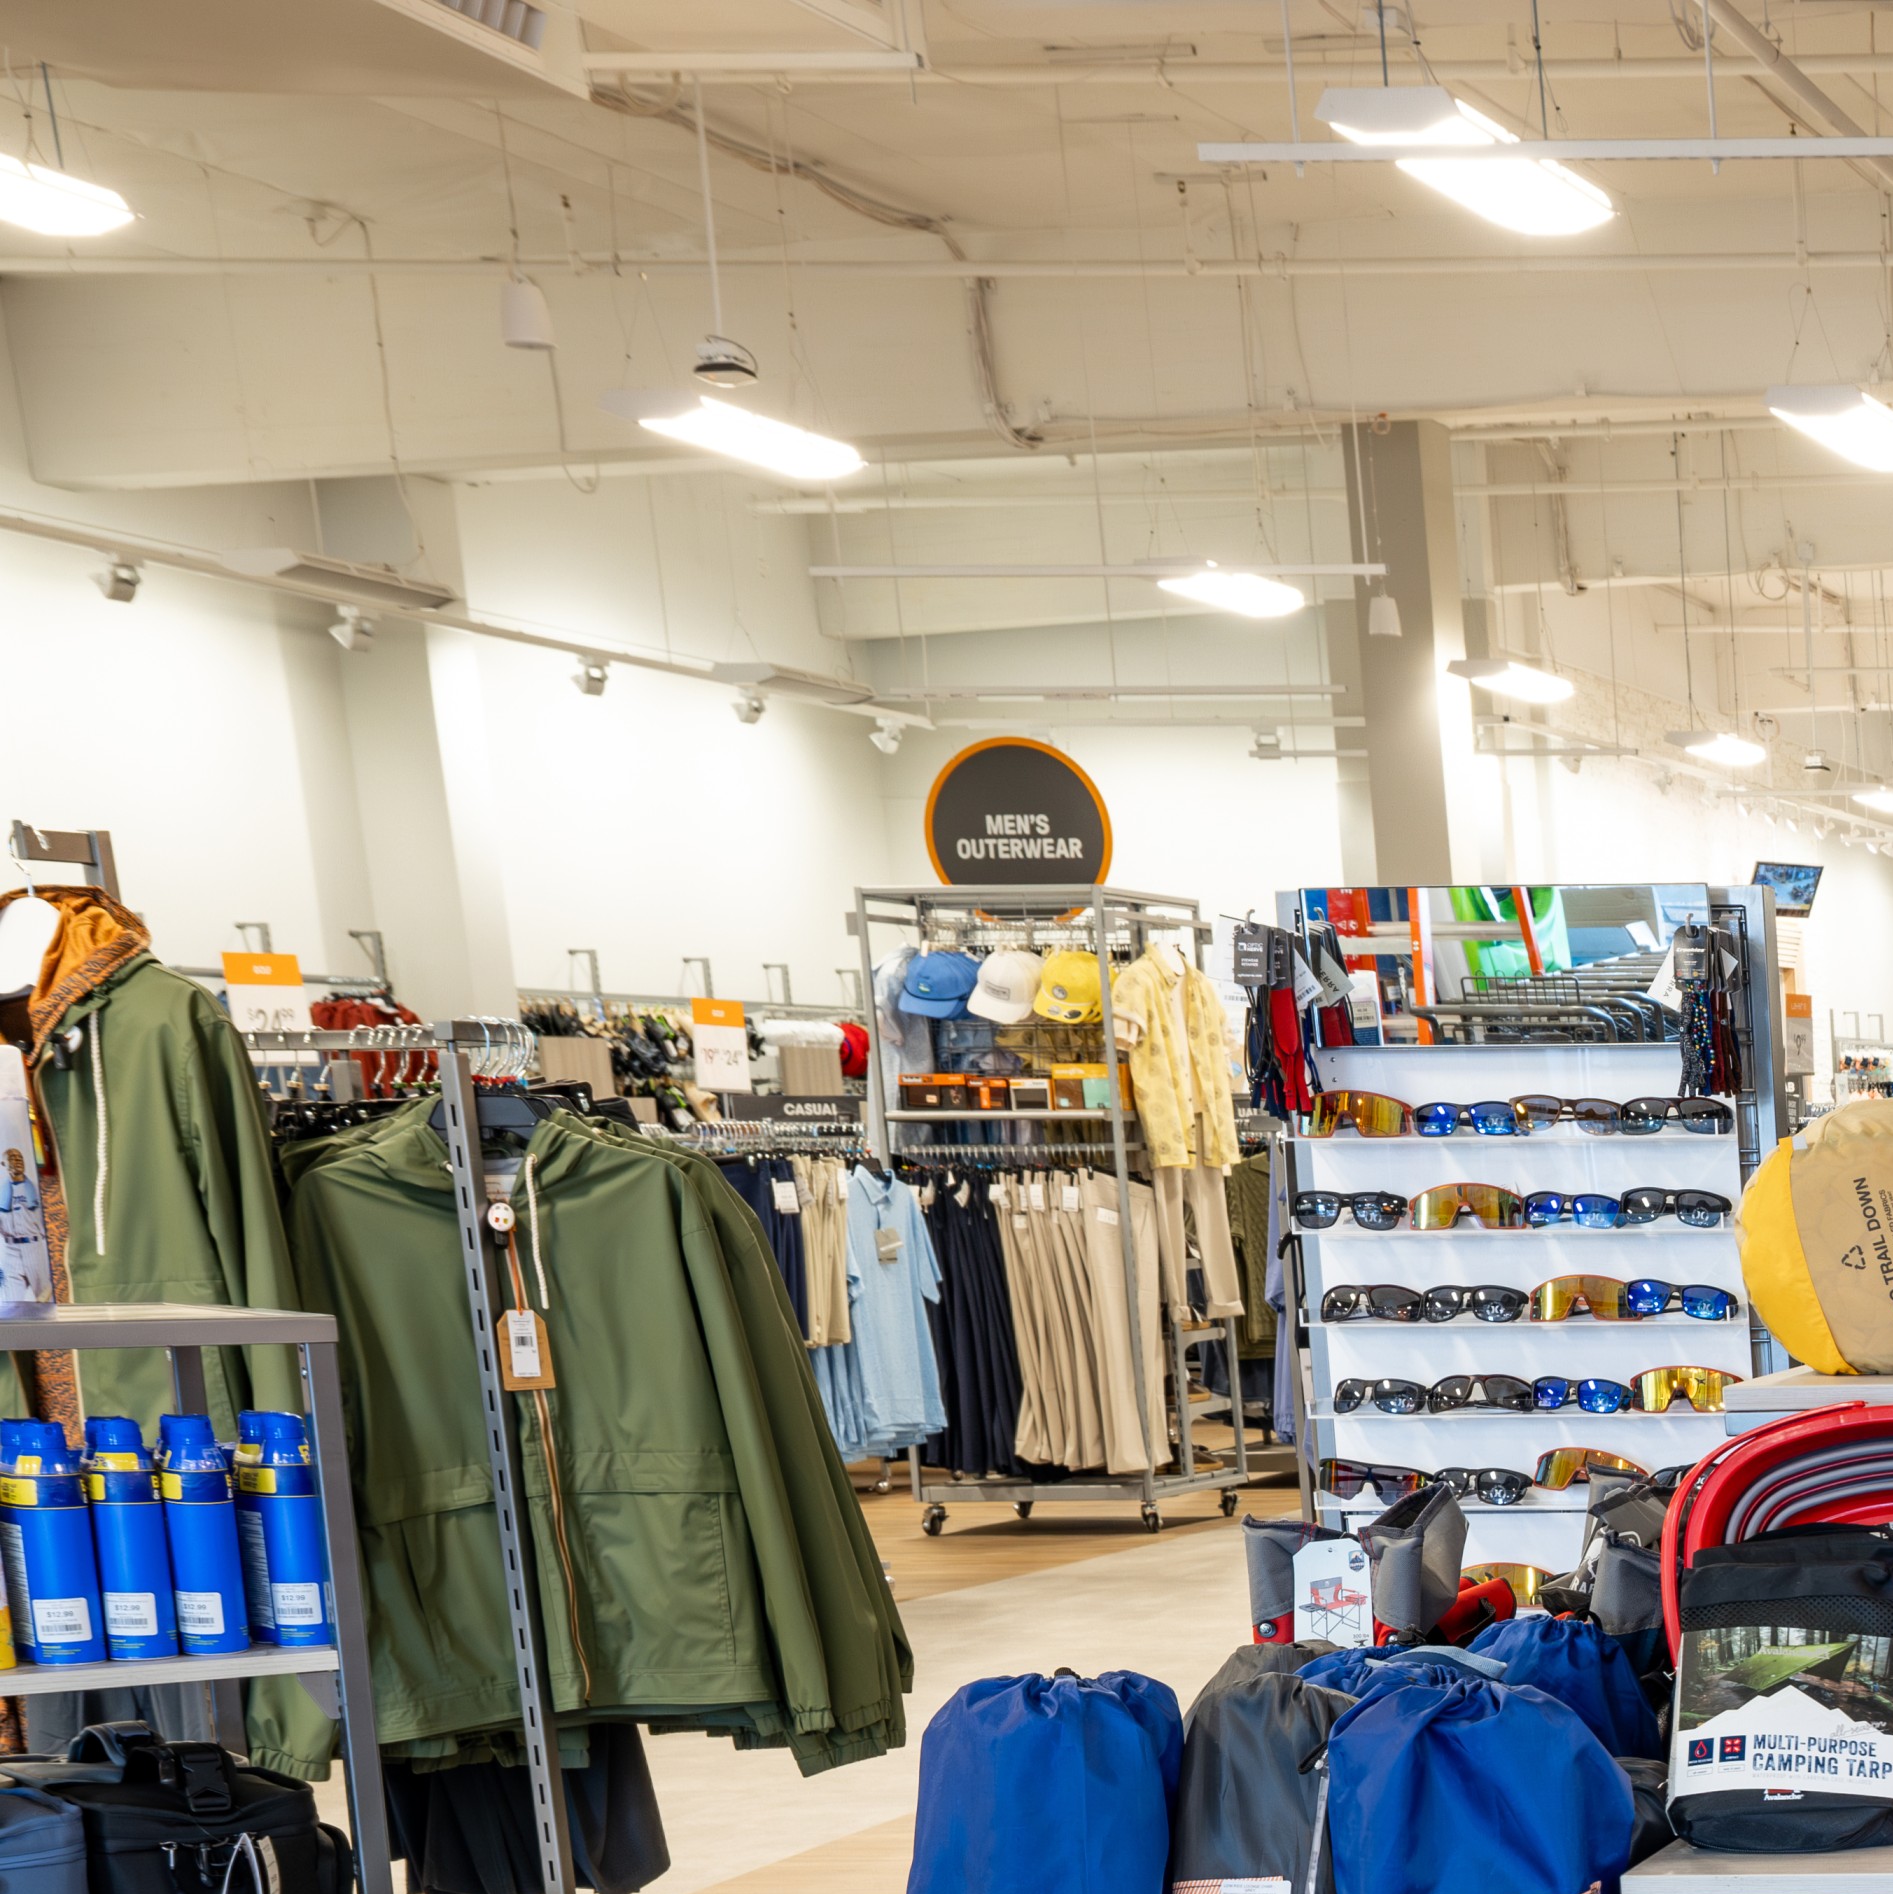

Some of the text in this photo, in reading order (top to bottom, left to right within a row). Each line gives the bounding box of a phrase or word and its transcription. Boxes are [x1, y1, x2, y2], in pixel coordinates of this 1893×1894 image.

[985, 815, 1050, 836] MEN'S
[956, 836, 1083, 861] OUTERWEAR
[783, 1102, 838, 1116] CASUAL
[1853, 1177, 1881, 1231] DOWN
[1753, 1734, 1877, 1758] MULTI-PURPOSE
[1752, 1752, 1839, 1775] CAMPING
[1846, 1759, 1893, 1779] TARP
